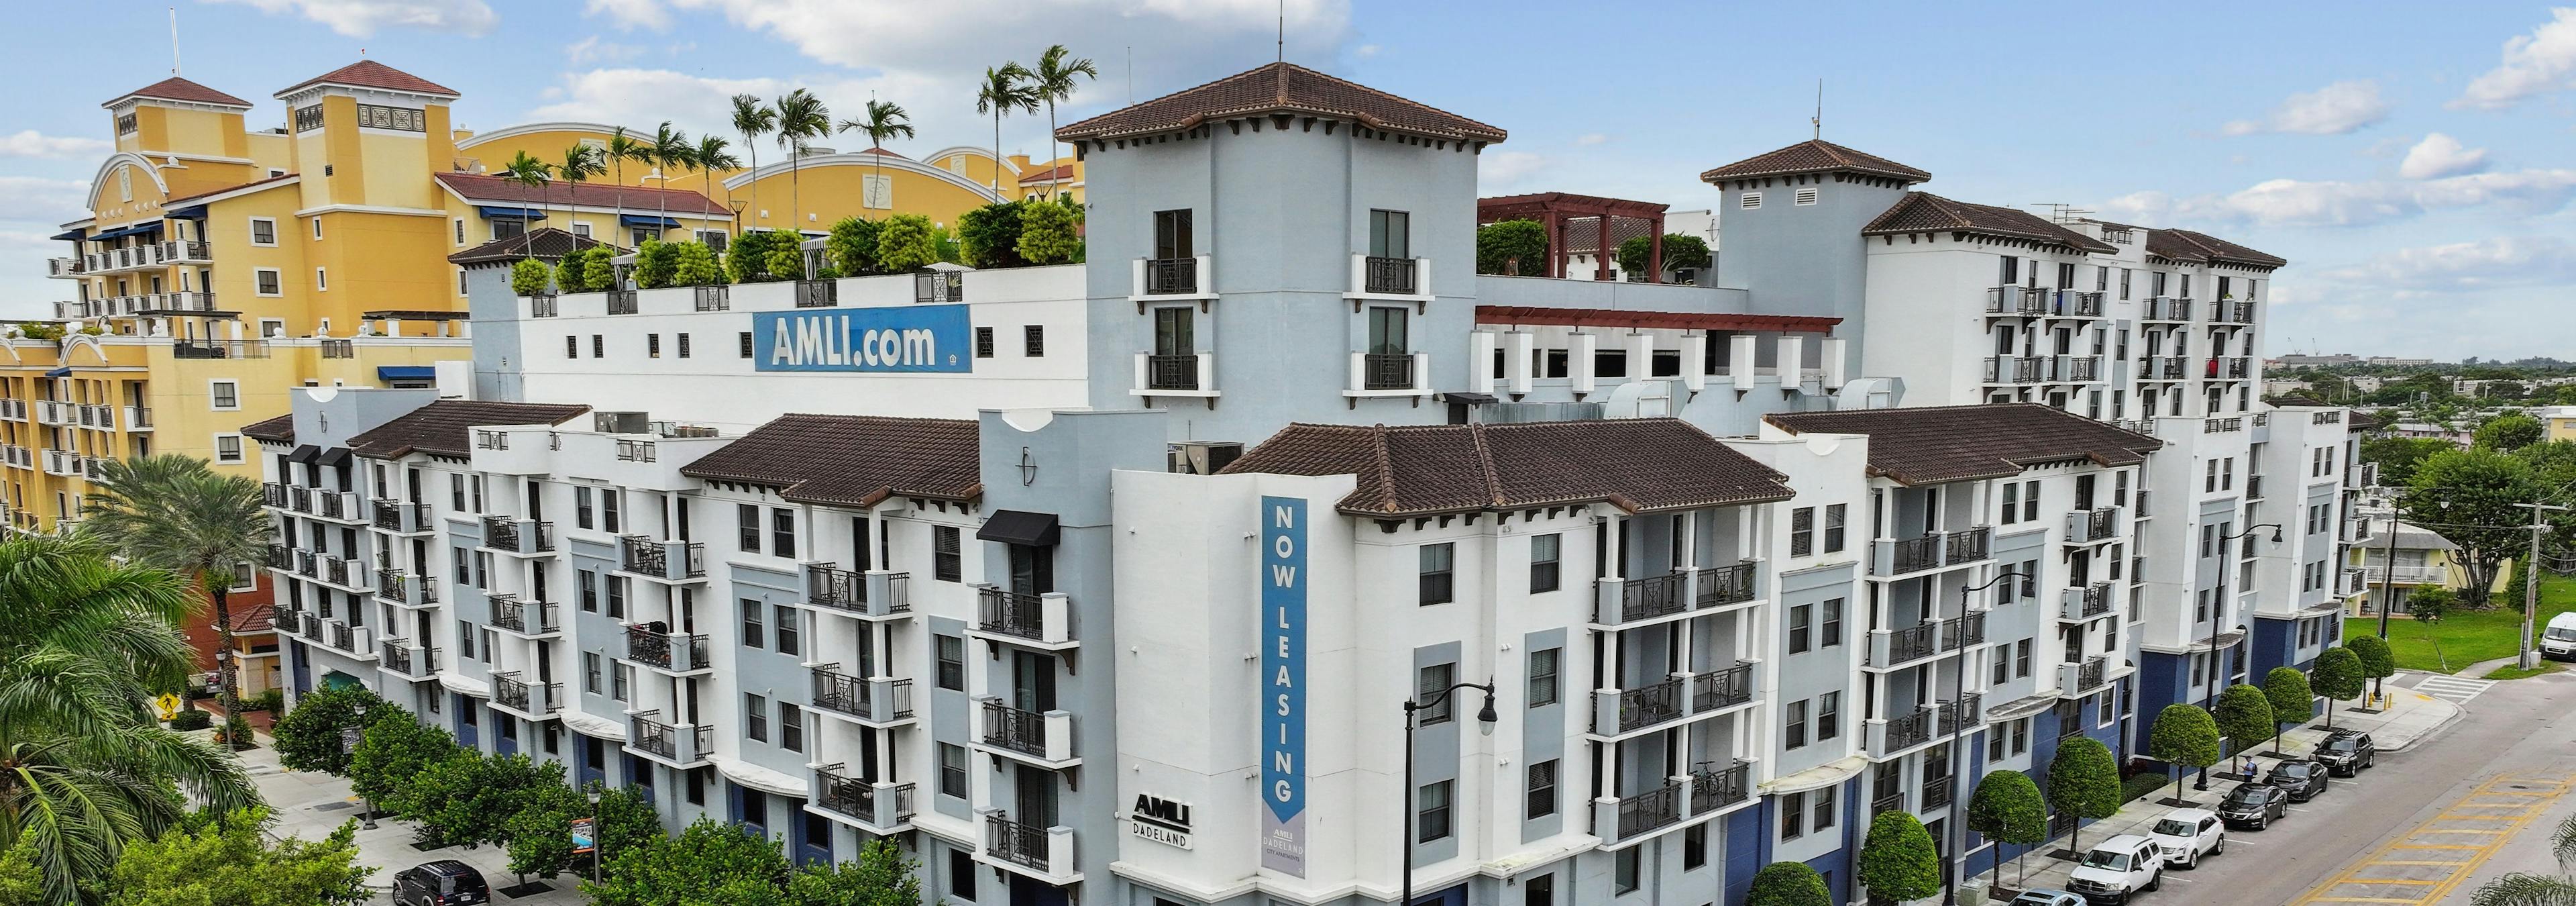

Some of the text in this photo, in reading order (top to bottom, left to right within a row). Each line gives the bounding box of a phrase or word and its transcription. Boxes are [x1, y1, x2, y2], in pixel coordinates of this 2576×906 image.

[772, 315, 935, 366] AMLI.com
[1273, 505, 1295, 803] NOW LEASING
[1134, 794, 1190, 825] AMLI
[1133, 823, 1186, 846] DADELAND
[1263, 837, 1303, 854] DADELAND
[1273, 829, 1293, 840] AMLI
[1276, 851, 1299, 862] APARTMENTS
